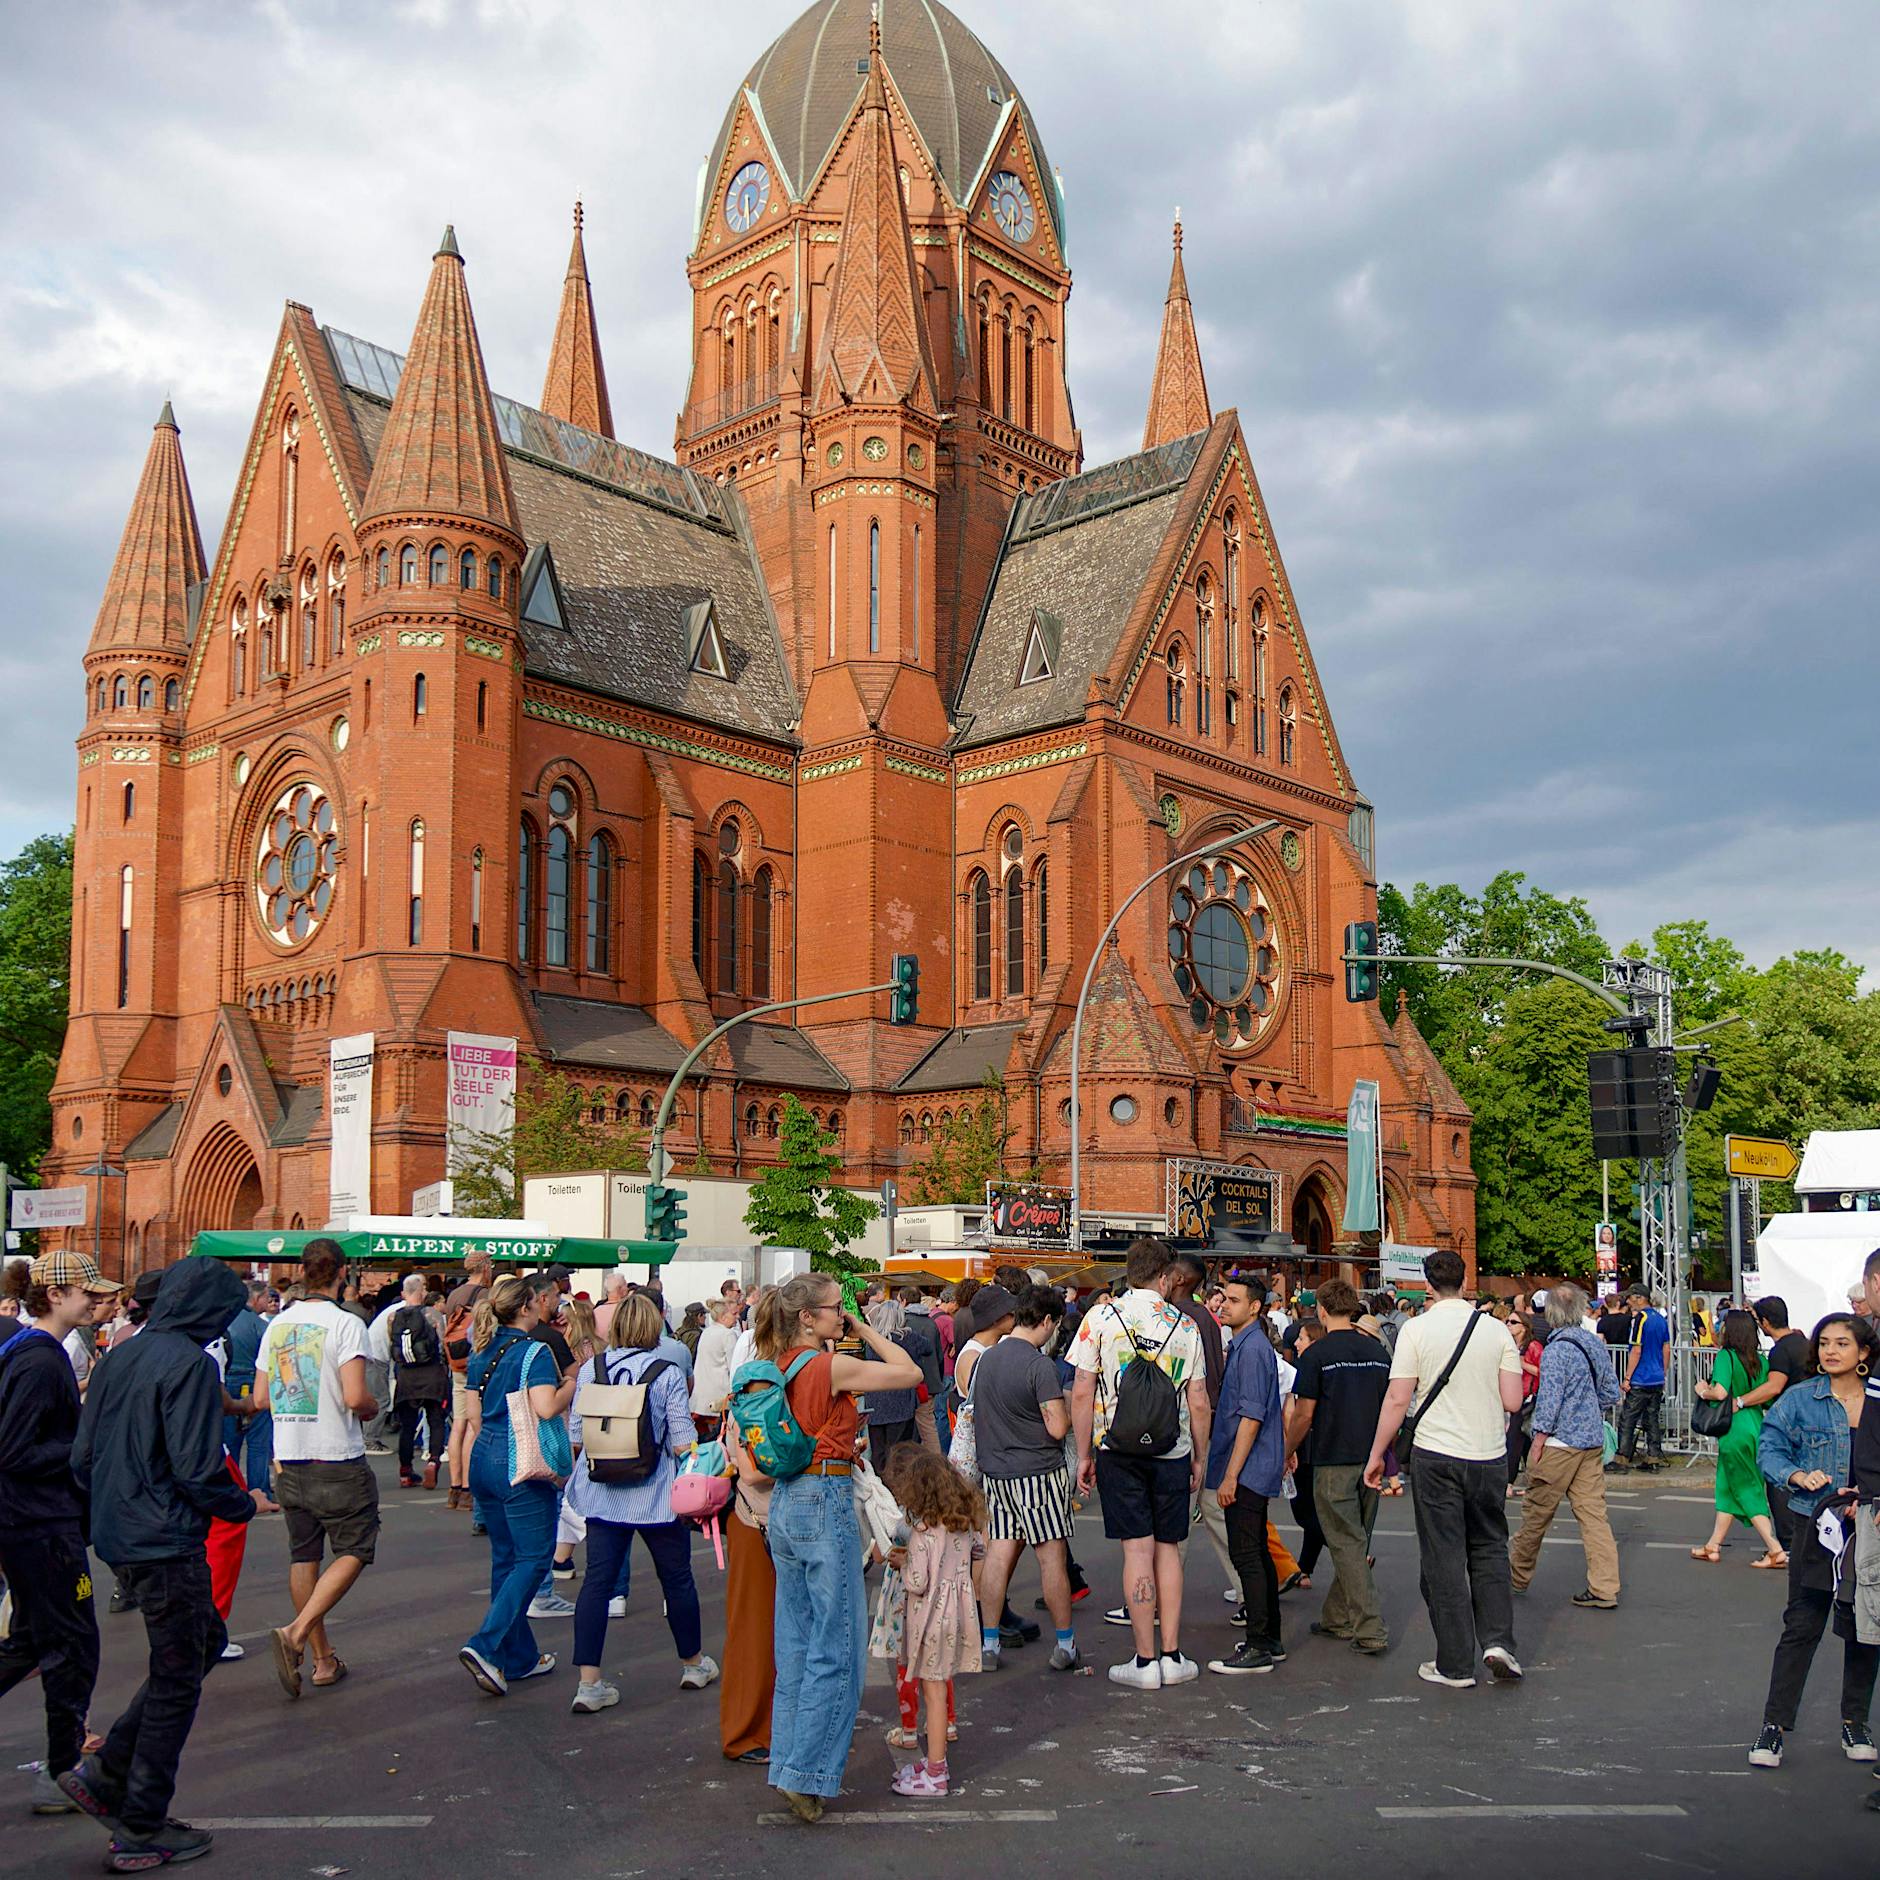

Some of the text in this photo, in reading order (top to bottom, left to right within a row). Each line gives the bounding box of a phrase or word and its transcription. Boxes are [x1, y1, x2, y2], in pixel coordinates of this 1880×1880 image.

[453, 1047, 492, 1063] LIEBE
[453, 1063, 511, 1081] TUT DER
[453, 1078, 494, 1094] SEELE
[453, 1094, 484, 1108] GUT.
[1744, 1150, 1778, 1167] Neukölln
[547, 1184, 582, 1195] Toiletten
[617, 1182, 646, 1194] Toilet
[1221, 1182, 1268, 1199] COCKTAILS
[1009, 1200, 1060, 1227] Crêpes
[1225, 1200, 1263, 1216] DEL SOL
[903, 1217, 927, 1225] Toiletten
[373, 1237, 557, 1257] ALPEN STOFF
